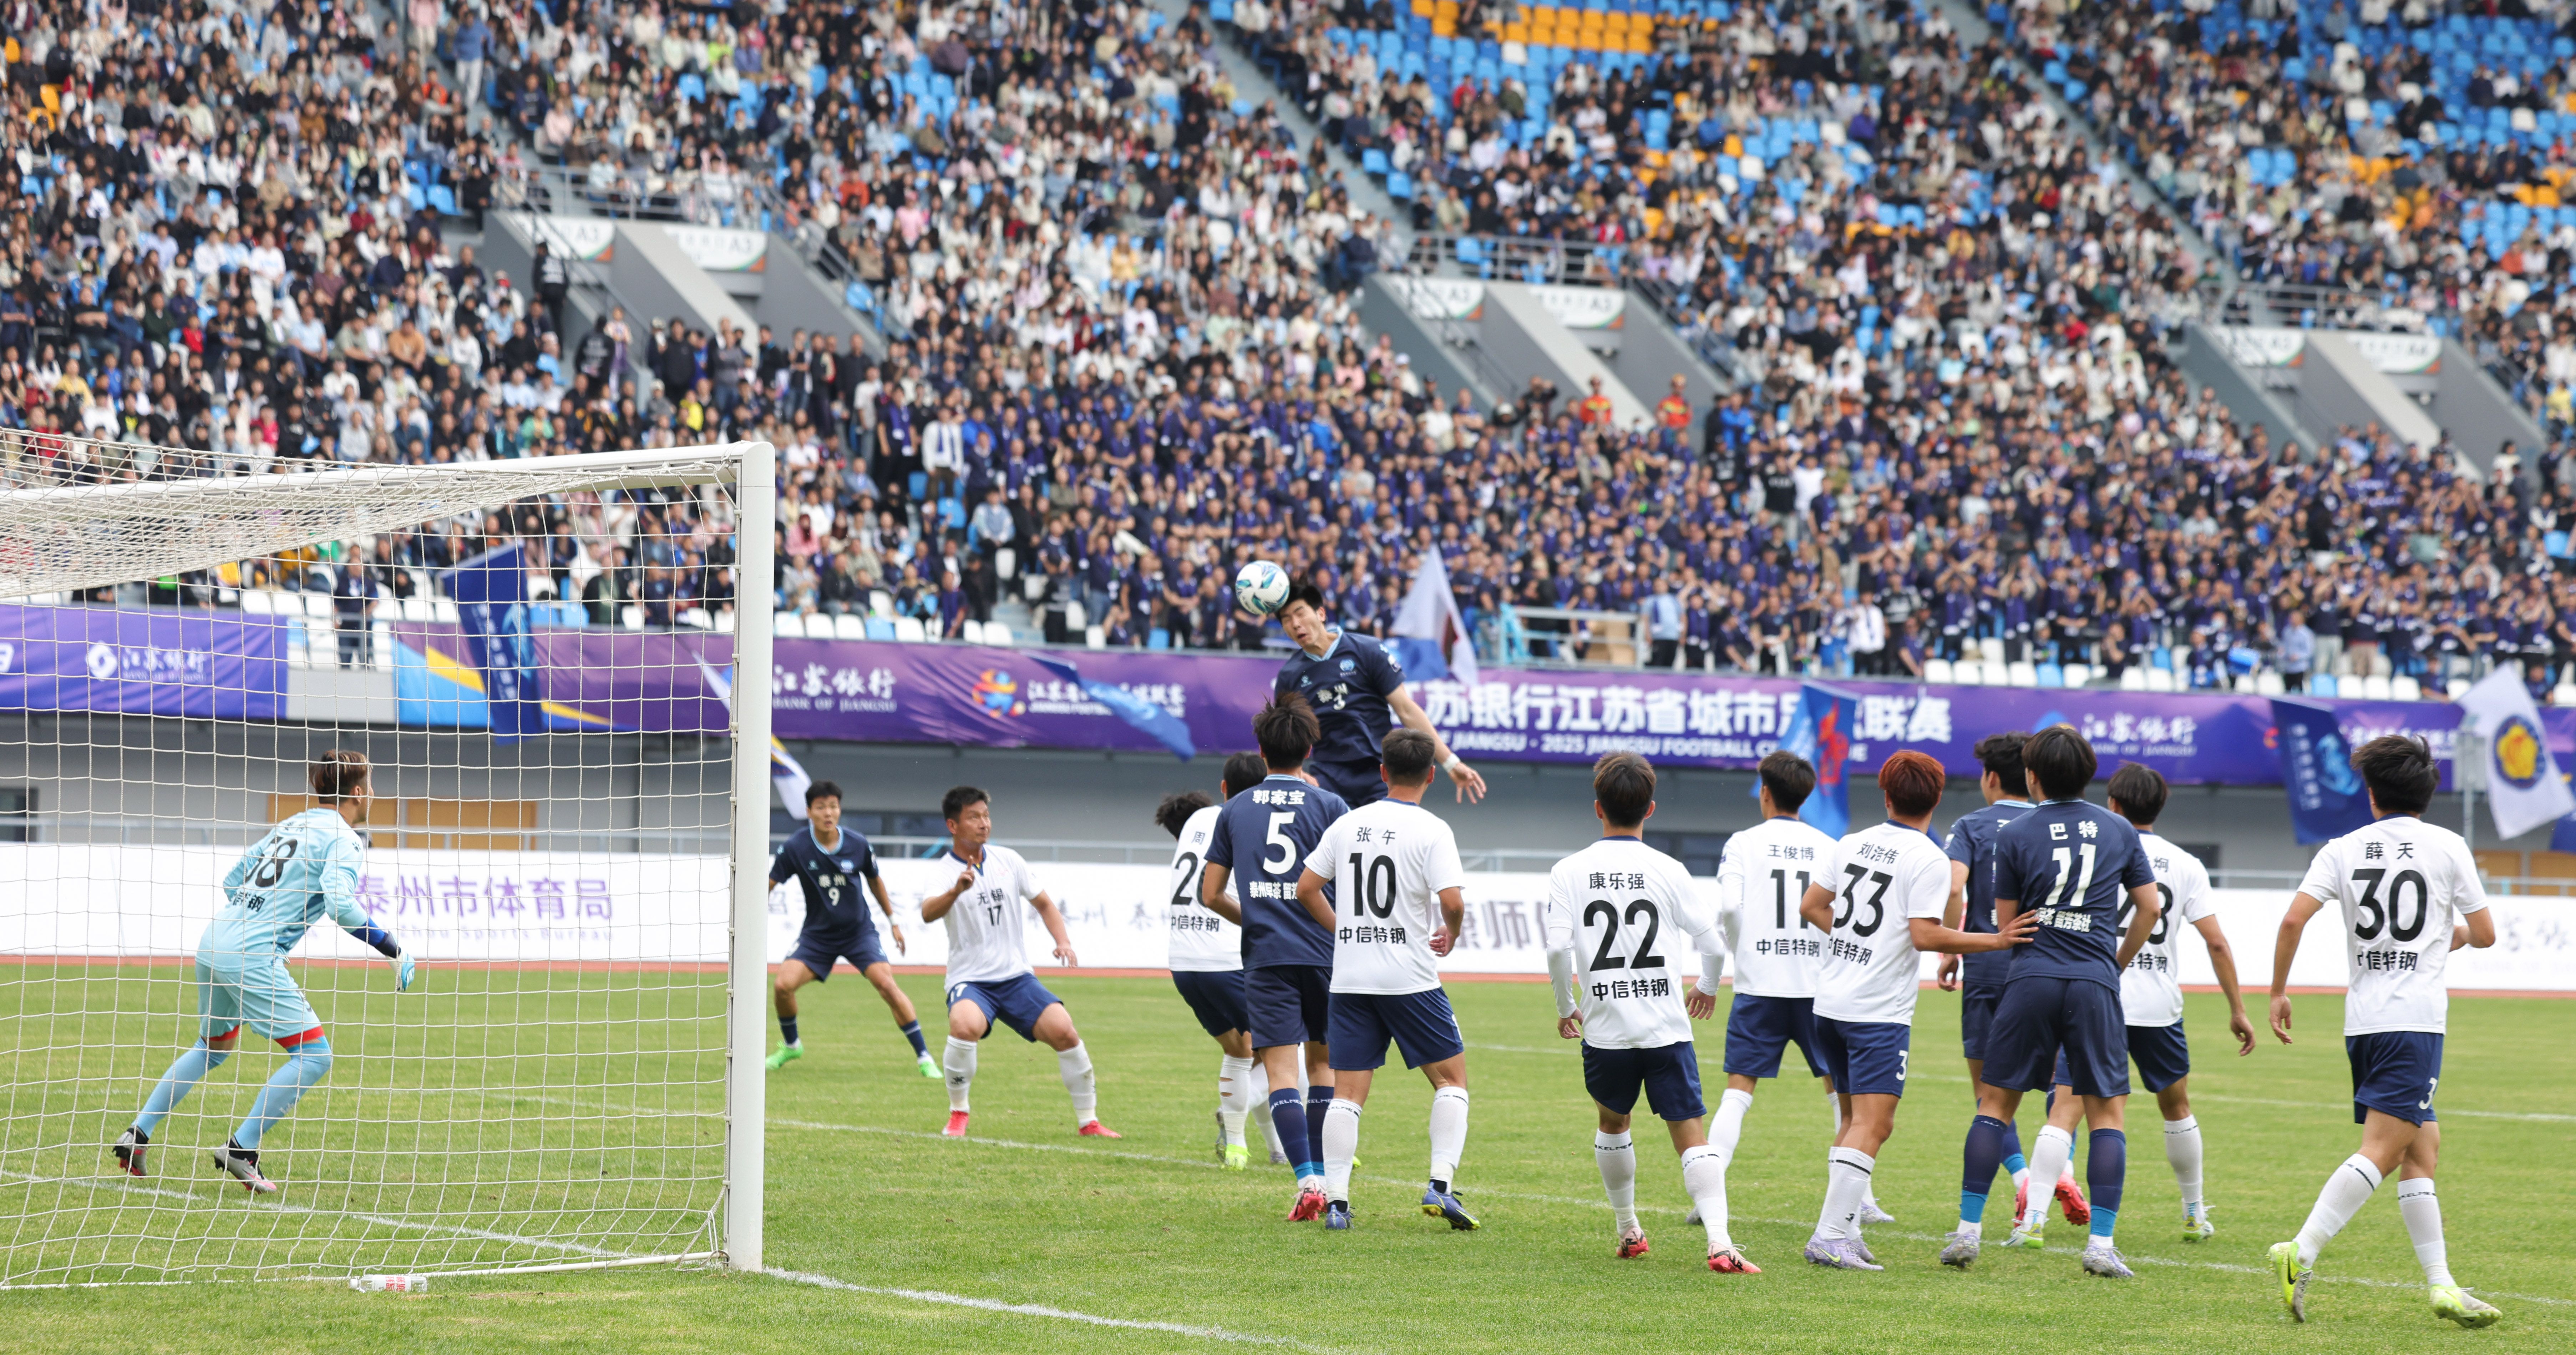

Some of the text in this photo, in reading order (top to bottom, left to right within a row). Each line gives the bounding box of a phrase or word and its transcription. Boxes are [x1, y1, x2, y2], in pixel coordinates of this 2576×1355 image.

[773, 661, 897, 699] 江苏银行
[1389, 679, 1952, 743] 苏银行江苏省城市联赛
[2081, 711, 2197, 745] 江苏银行
[1662, 737, 1755, 758] FOOTBALL
[1252, 790, 1305, 805] 郭家宝
[1356, 827, 1395, 845] 张午
[2049, 821, 2098, 840] 巴特
[1263, 812, 1297, 874] 5
[1768, 844, 1815, 861] 王俊博
[2365, 841, 2414, 860] 薛天
[1172, 851, 1208, 908] 2
[1349, 852, 1396, 919] 10
[1589, 872, 1645, 890] 康乐强
[2045, 843, 2096, 907] 11
[356, 875, 612, 920] 泰州市体育局
[828, 887, 840, 906] 9
[977, 888, 1004, 906] 无锡
[1249, 881, 1281, 899] 泰州早茶
[1770, 869, 1810, 929] 11
[1833, 863, 1893, 937] 33
[987, 905, 1002, 926] 17
[2351, 868, 2427, 942] 30
[1339, 926, 1406, 945] 中信特钢
[1583, 899, 1665, 972] 22
[1756, 939, 1820, 957] 中信特钢
[1592, 979, 1669, 1001] 中信特钢
